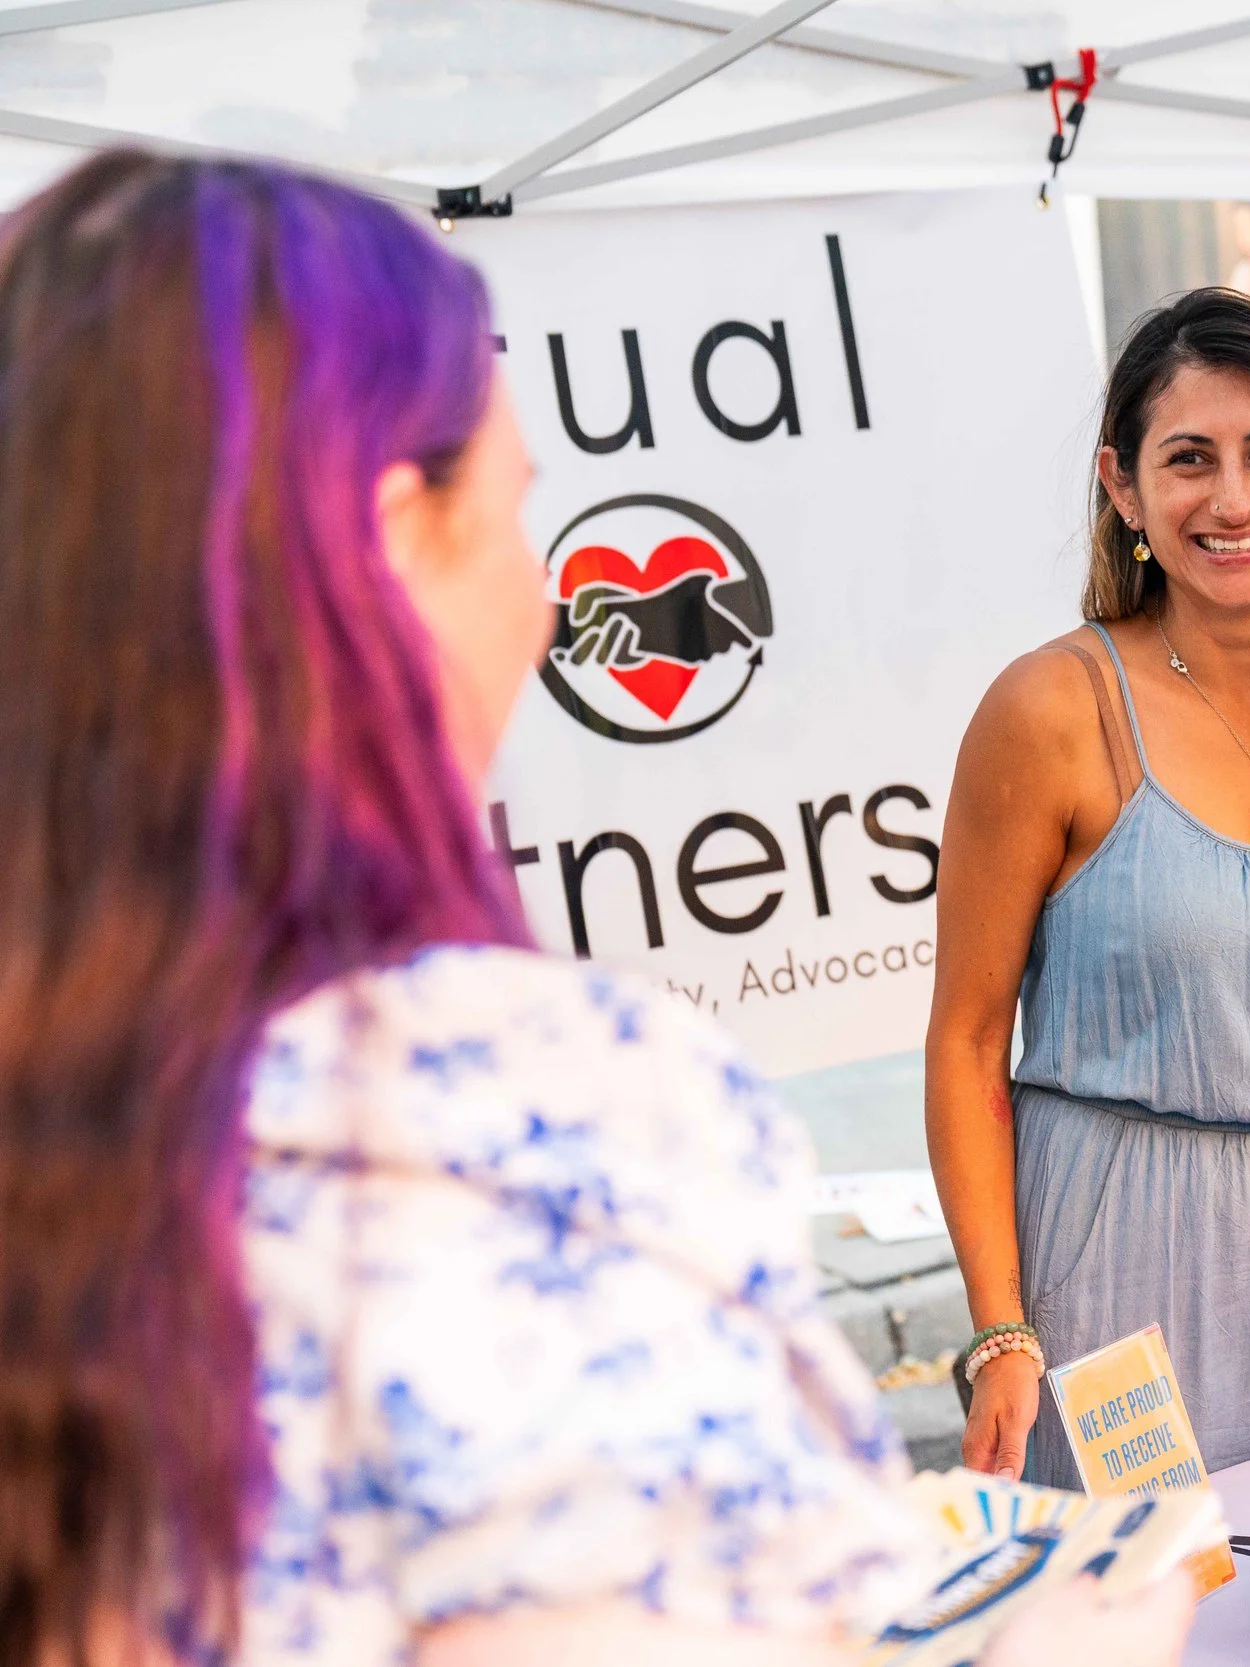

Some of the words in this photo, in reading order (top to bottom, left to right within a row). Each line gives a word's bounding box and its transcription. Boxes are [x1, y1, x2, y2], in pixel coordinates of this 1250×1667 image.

[490, 233, 871, 456] ual
[1077, 1409, 1102, 1443] WE
[1100, 1396, 1129, 1433] ARE
[1126, 1375, 1172, 1419] PROUD
[1102, 1449, 1123, 1480] TO
[1121, 1422, 1176, 1471] RECEIVE
